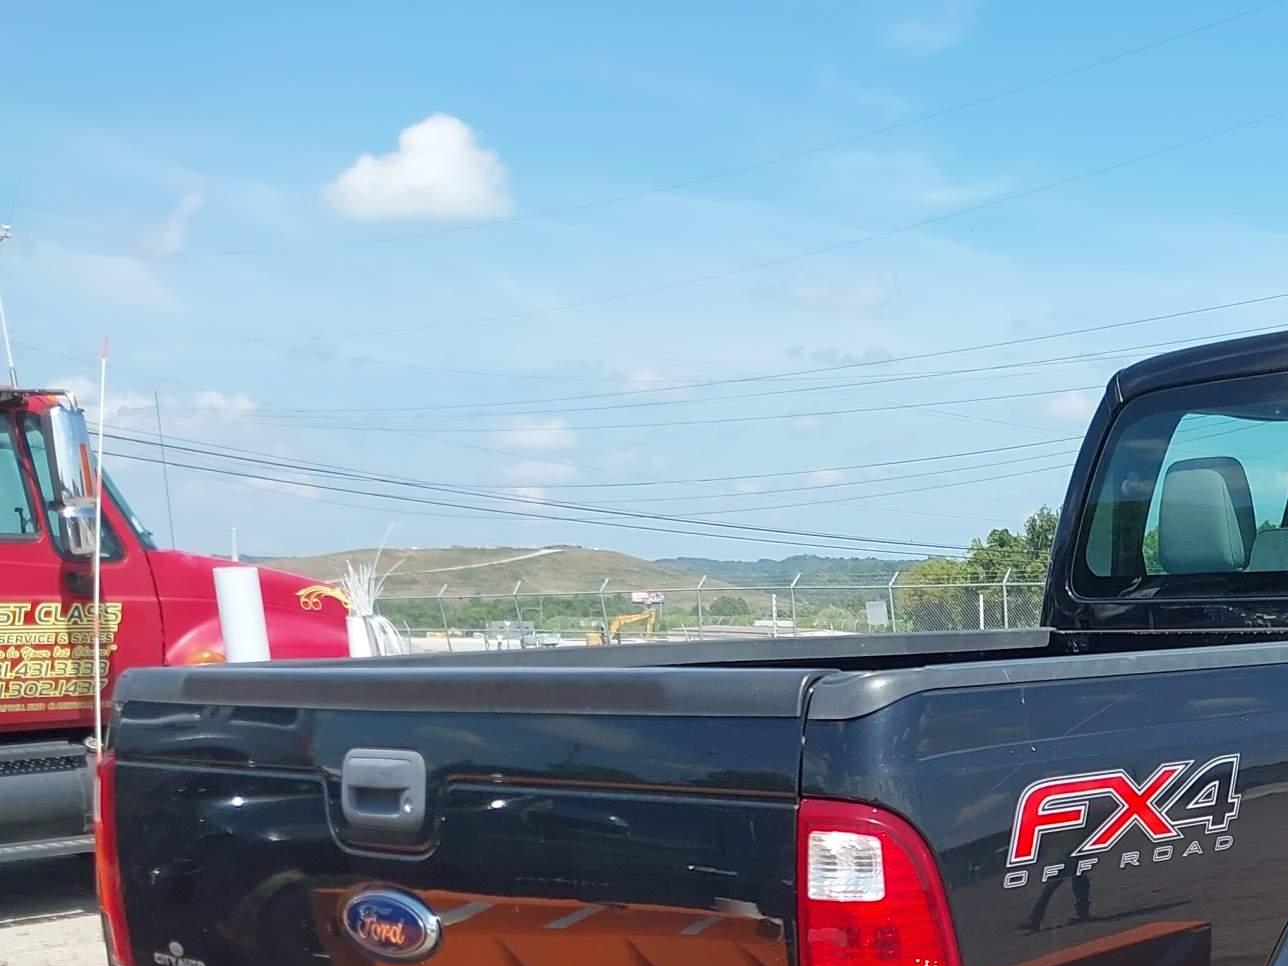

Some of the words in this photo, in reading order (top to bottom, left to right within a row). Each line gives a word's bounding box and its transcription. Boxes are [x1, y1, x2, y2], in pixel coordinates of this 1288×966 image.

[35, 602, 122, 625] CLASS
[0, 632, 56, 645] SERVICE
[57, 632, 69, 644] &
[71, 632, 114, 644] SALES
[1006, 753, 1242, 868] FX4
[1003, 857, 1098, 889] OFF
[1120, 835, 1235, 869] ROAD
[357, 904, 406, 945] Ford
